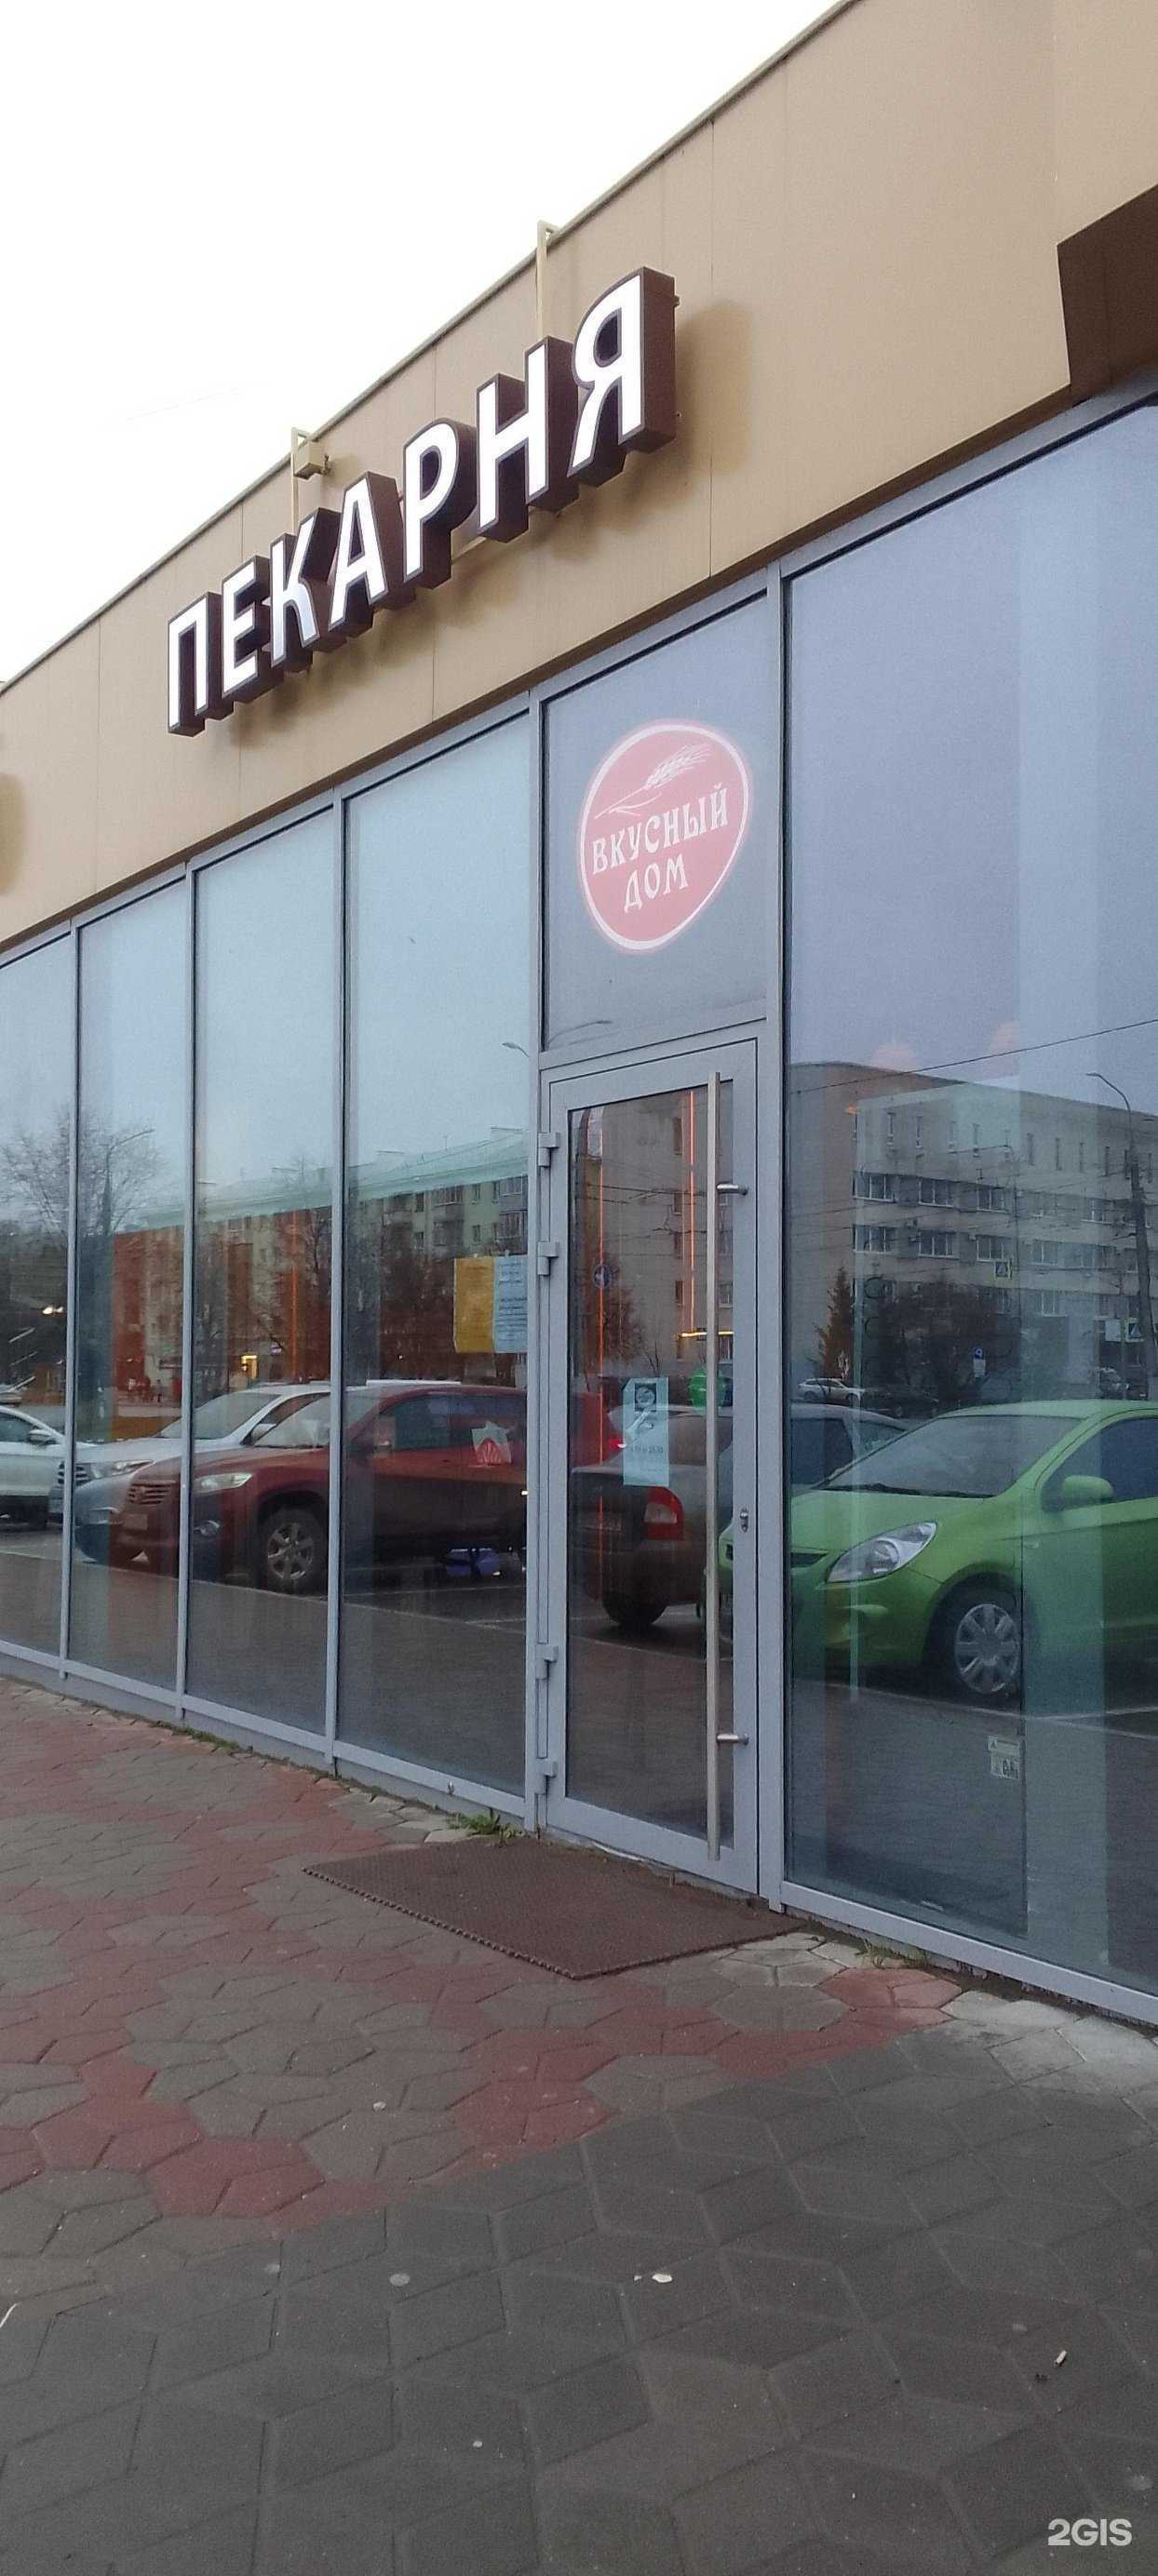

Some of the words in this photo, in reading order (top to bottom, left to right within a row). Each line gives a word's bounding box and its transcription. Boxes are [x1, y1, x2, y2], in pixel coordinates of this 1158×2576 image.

[168, 267, 650, 734] ПЕКАРНЯ
[592, 782, 729, 875] ВКУСНЫЙ
[624, 853, 689, 913] ДОМ
